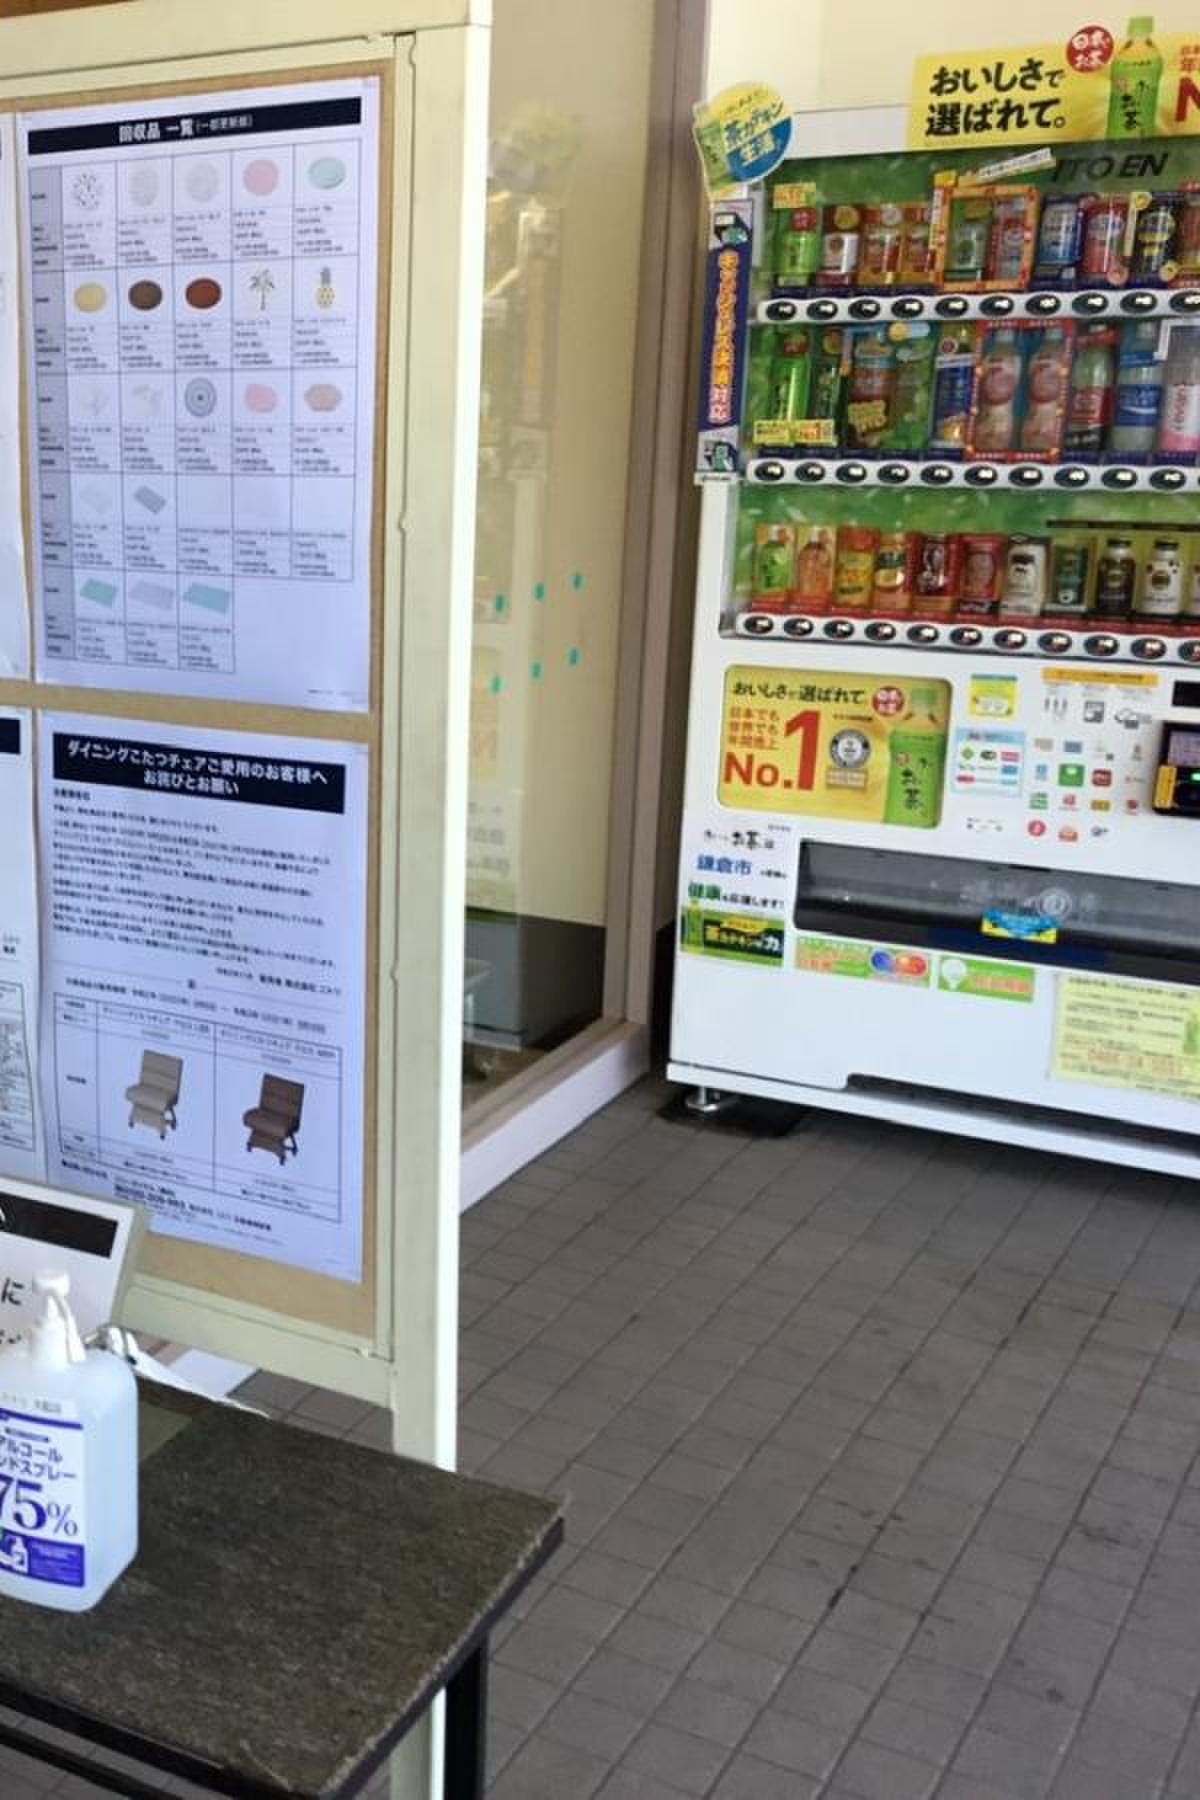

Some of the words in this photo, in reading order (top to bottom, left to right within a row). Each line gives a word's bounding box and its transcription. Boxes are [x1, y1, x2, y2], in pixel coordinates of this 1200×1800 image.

[930, 59, 1065, 96] おいしさで
[925, 97, 1066, 137] 選ばれて。
